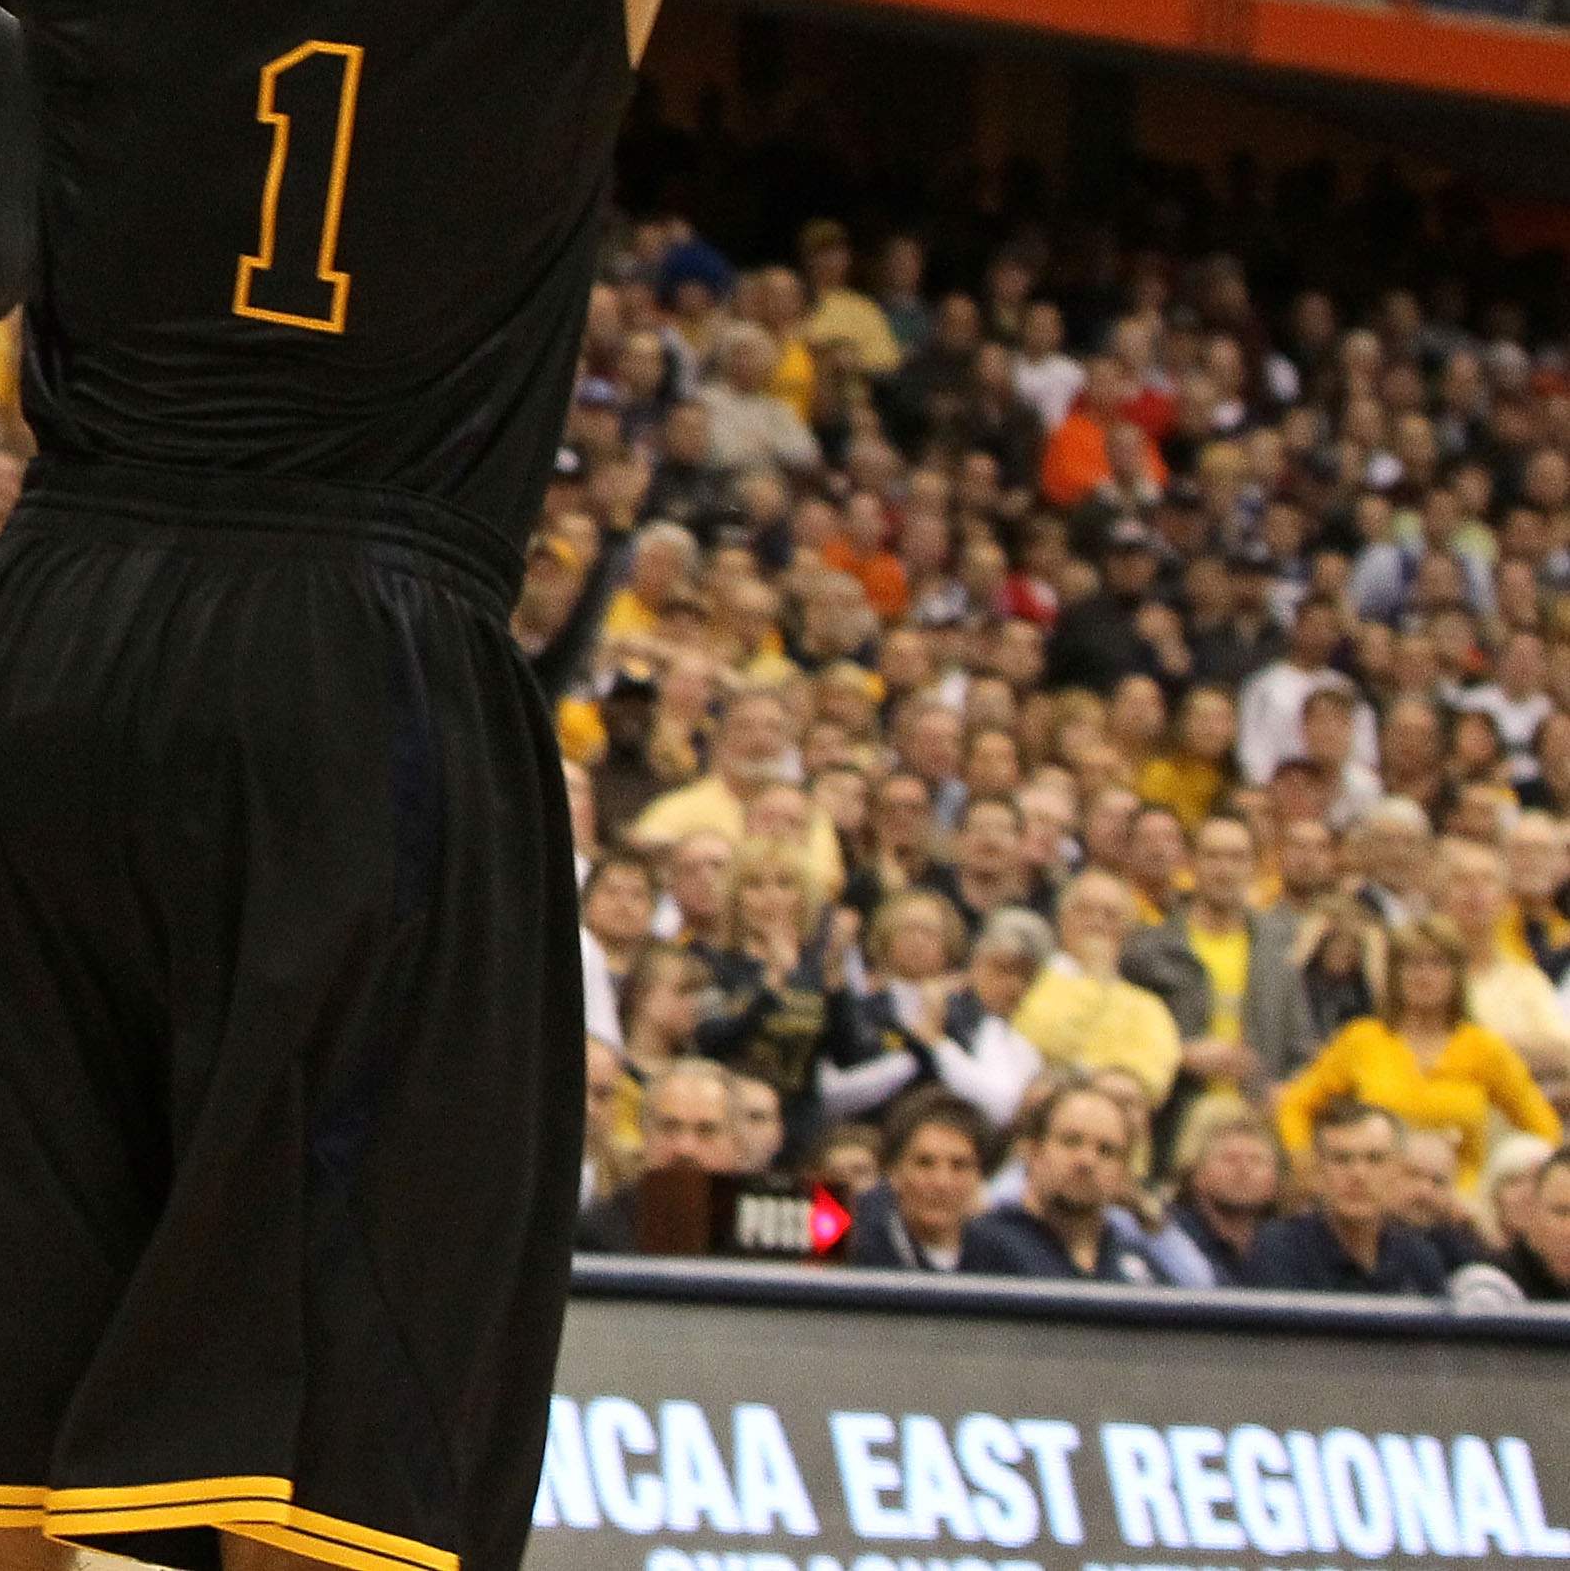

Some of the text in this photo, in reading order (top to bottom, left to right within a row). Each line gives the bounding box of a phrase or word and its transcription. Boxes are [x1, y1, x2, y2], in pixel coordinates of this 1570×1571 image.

[232, 39, 365, 333] 1
[532, 1394, 1570, 1559] NCAA EAST REGIONAL
